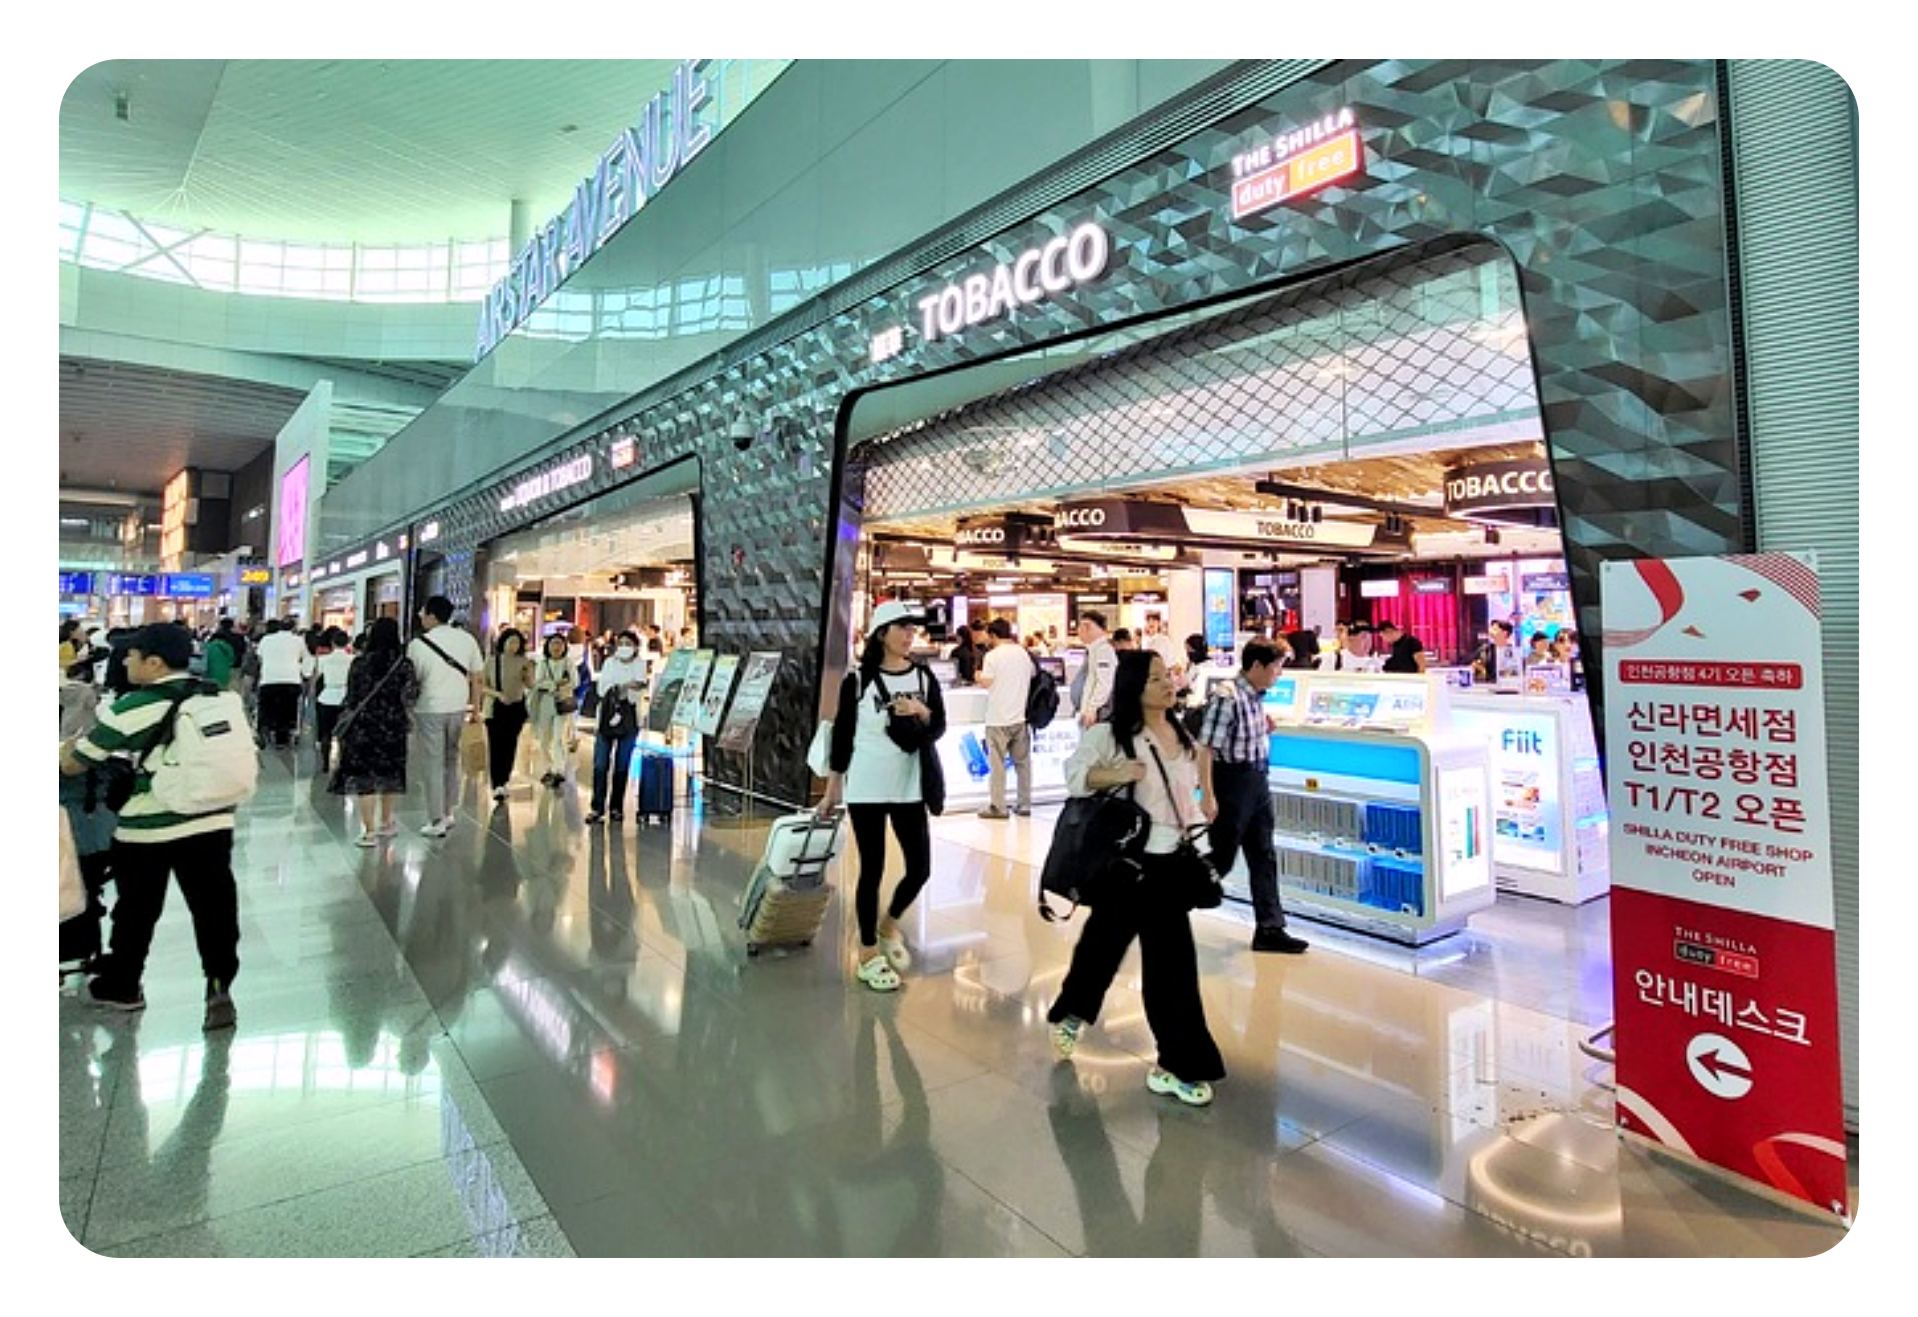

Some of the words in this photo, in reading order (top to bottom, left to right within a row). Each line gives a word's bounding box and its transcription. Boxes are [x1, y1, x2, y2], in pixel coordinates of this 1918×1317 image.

[1231, 146, 1272, 177] THE
[1275, 107, 1355, 158] SHILLA
[561, 59, 713, 276] AVENUE
[1239, 174, 1286, 206] duty
[1297, 149, 1345, 181] free
[917, 221, 1109, 342] TOBACCO
[1256, 520, 1314, 539] TOBACCO
[1626, 664, 1696, 681] 인천공항점
[1698, 667, 1721, 682] 4기
[1726, 668, 1756, 684] 오픈
[1760, 669, 1793, 685] 축하
[1501, 727, 1543, 756] Fiit
[1626, 701, 1798, 743] 신라면세점
[1627, 740, 1798, 788] 인천공항점
[1624, 781, 1720, 820] T1/T2
[1733, 792, 1807, 833] 오픈
[1623, 823, 1674, 842] SHILLA
[1675, 830, 1716, 849] DUTY
[1720, 836, 1762, 856] FREE
[1765, 844, 1815, 864] SHOP
[1645, 843, 1714, 866] INCHEON
[1716, 854, 1788, 878] AIRPORT
[1692, 868, 1736, 888] OPEN
[1674, 926, 1701, 941] THE
[1704, 932, 1757, 955] SHILLA
[1678, 944, 1712, 965] duty
[1719, 954, 1752, 972] free
[1634, 969, 1812, 1046] 안내데스크
